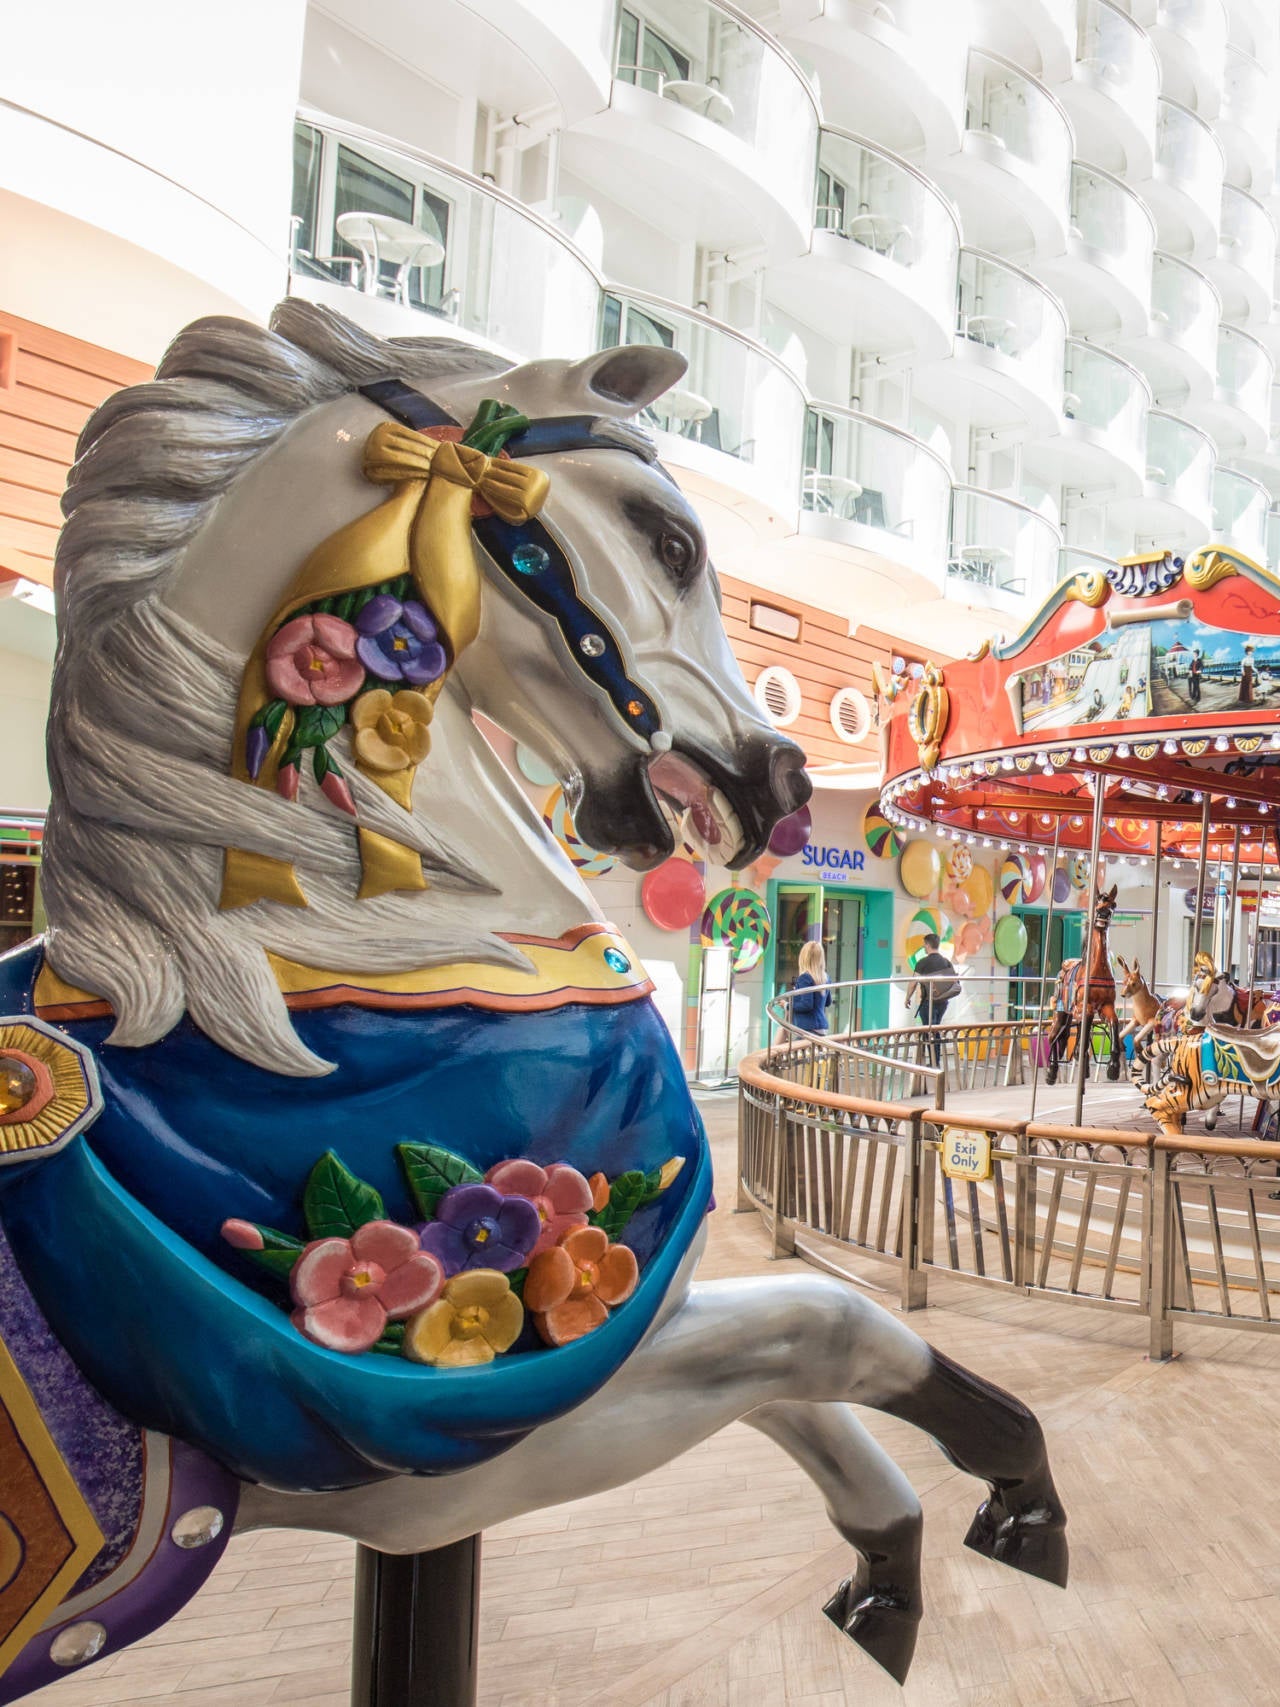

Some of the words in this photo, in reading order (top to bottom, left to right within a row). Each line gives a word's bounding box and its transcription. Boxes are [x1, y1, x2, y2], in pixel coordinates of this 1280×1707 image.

[802, 844, 865, 871] SUGAR
[822, 871, 847, 880] BEACH
[955, 1141, 977, 1155] Exit
[951, 1154, 979, 1171] Only
